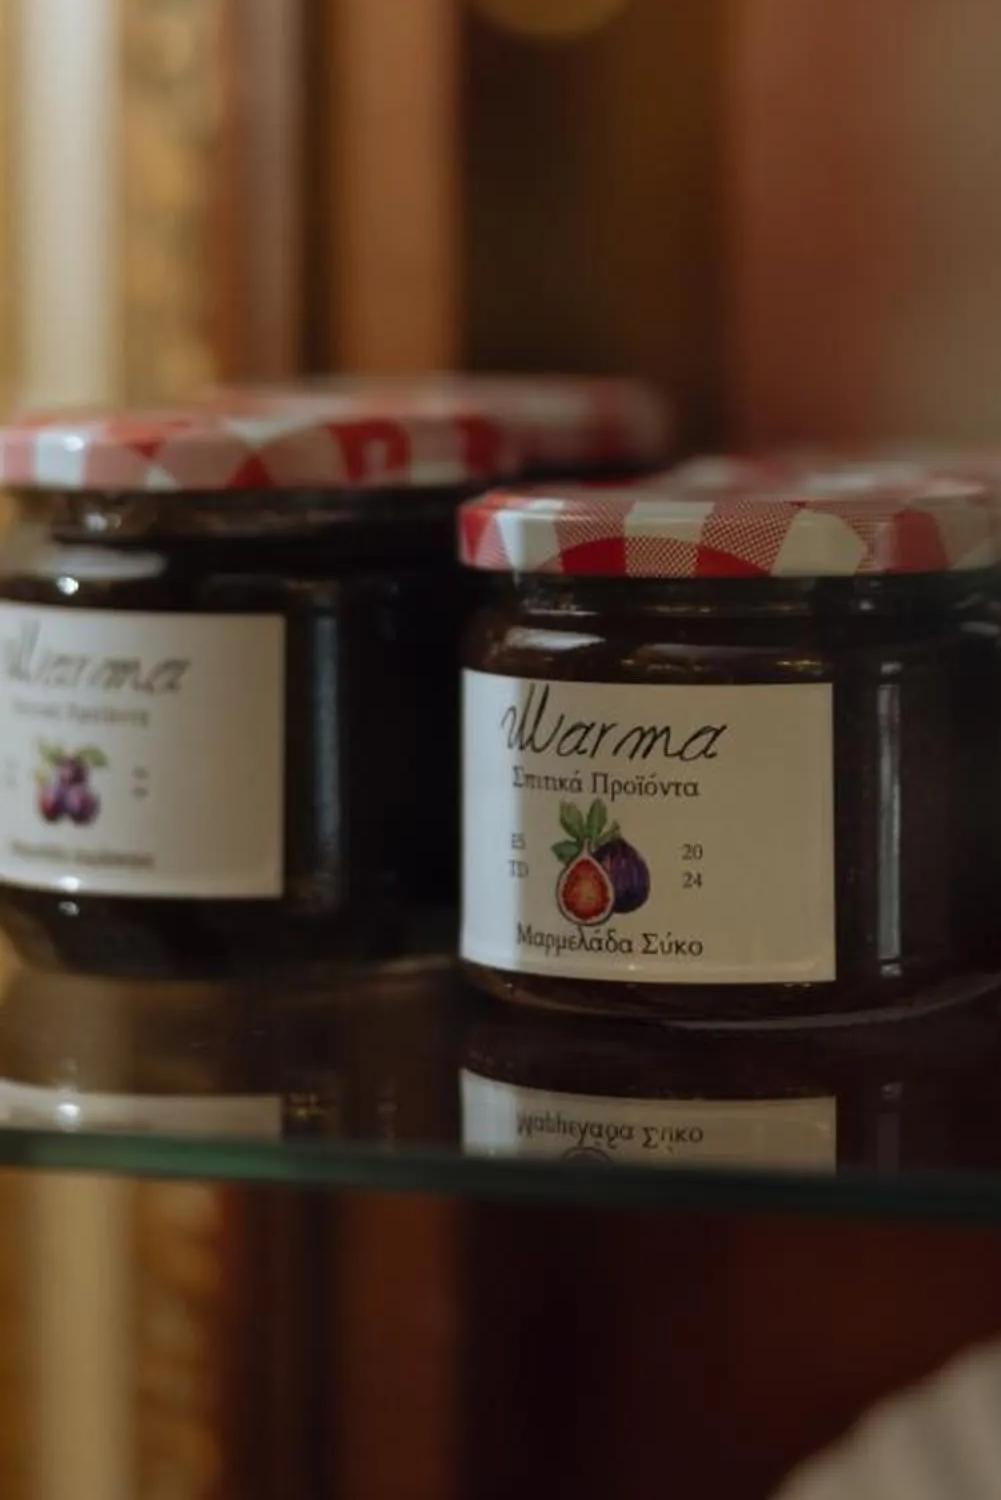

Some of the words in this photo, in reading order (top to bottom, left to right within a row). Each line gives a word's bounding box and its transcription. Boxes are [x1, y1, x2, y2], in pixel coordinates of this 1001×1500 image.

[500, 683, 728, 762] Warma
[512, 765, 583, 793] Σπιτικά
[591, 771, 702, 802] Προϊόντα
[681, 843, 704, 861] 20
[681, 871, 704, 890] 24
[516, 921, 633, 957] Μαρμελάδα
[641, 932, 704, 957] Σύκο
